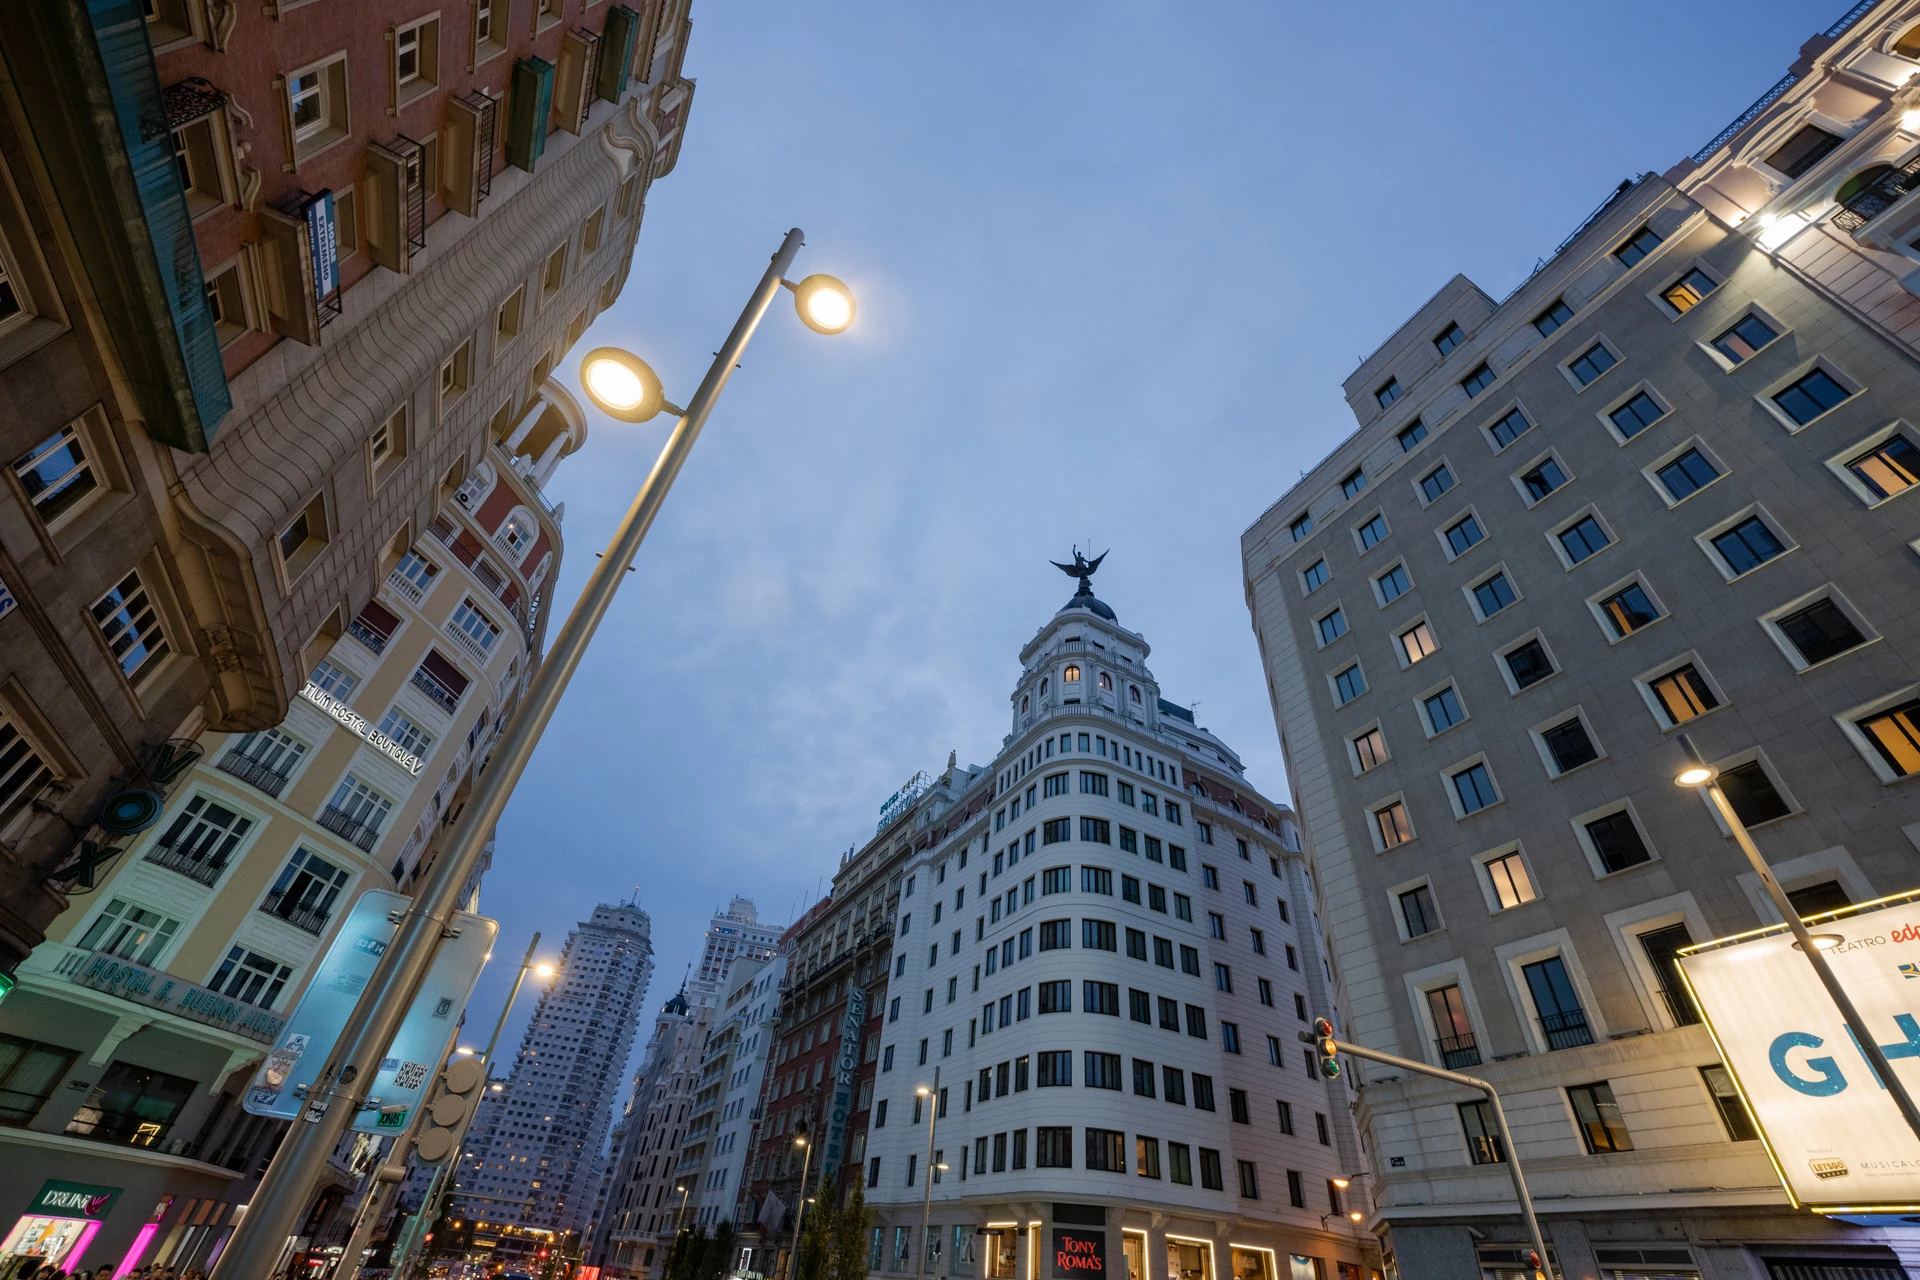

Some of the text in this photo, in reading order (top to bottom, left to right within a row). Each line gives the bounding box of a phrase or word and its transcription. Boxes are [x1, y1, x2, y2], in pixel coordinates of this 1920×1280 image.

[328, 221, 337, 264] HOGAR
[329, 701, 367, 736] HOSTAL
[367, 730, 414, 768] BOUTIQUE
[1830, 935, 1886, 955] TEATRO
[87, 956, 285, 1036] HOSTAL R. BUENOS AIRES
[838, 989, 863, 1086] SENATOR
[1813, 1161, 1844, 1172] LETSGO
[42, 1190, 91, 1209] DRUNI
[1062, 1236, 1096, 1254] TONY
[1057, 1251, 1102, 1271] ROMA'S
